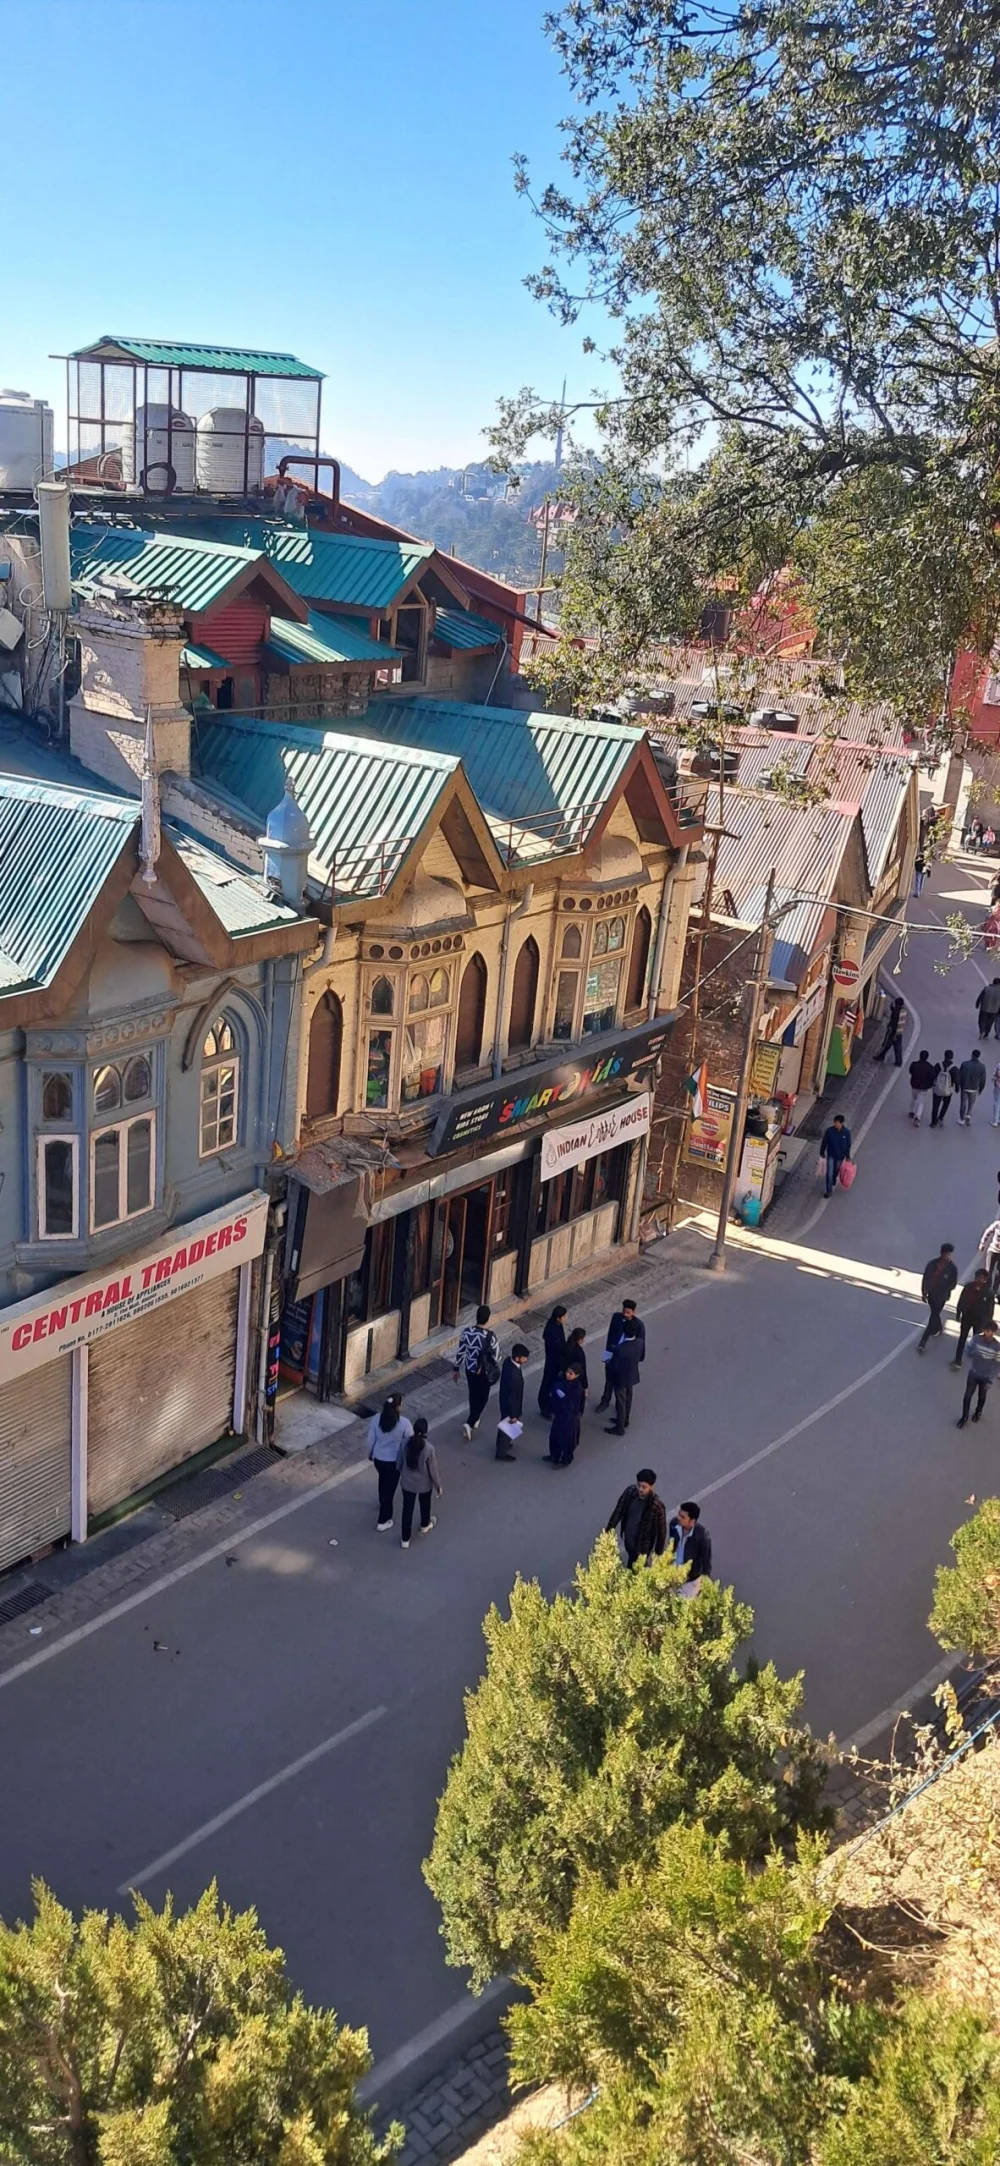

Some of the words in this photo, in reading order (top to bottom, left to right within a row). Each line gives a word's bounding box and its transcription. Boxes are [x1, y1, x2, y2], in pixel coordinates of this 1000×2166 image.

[832, 967, 860, 979] Hawkins
[498, 1083, 564, 1123] SMART
[556, 1134, 588, 1158] INDIAN
[619, 1107, 648, 1130] HOUSE
[11, 1275, 133, 1351] CENTRAL
[141, 1217, 248, 1289] TRADERS
[106, 1300, 127, 1316] HOUSE
[127, 1296, 136, 1306] OF
[136, 1278, 172, 1300] APPLIANCES
[58, 1339, 77, 1352] Phone
